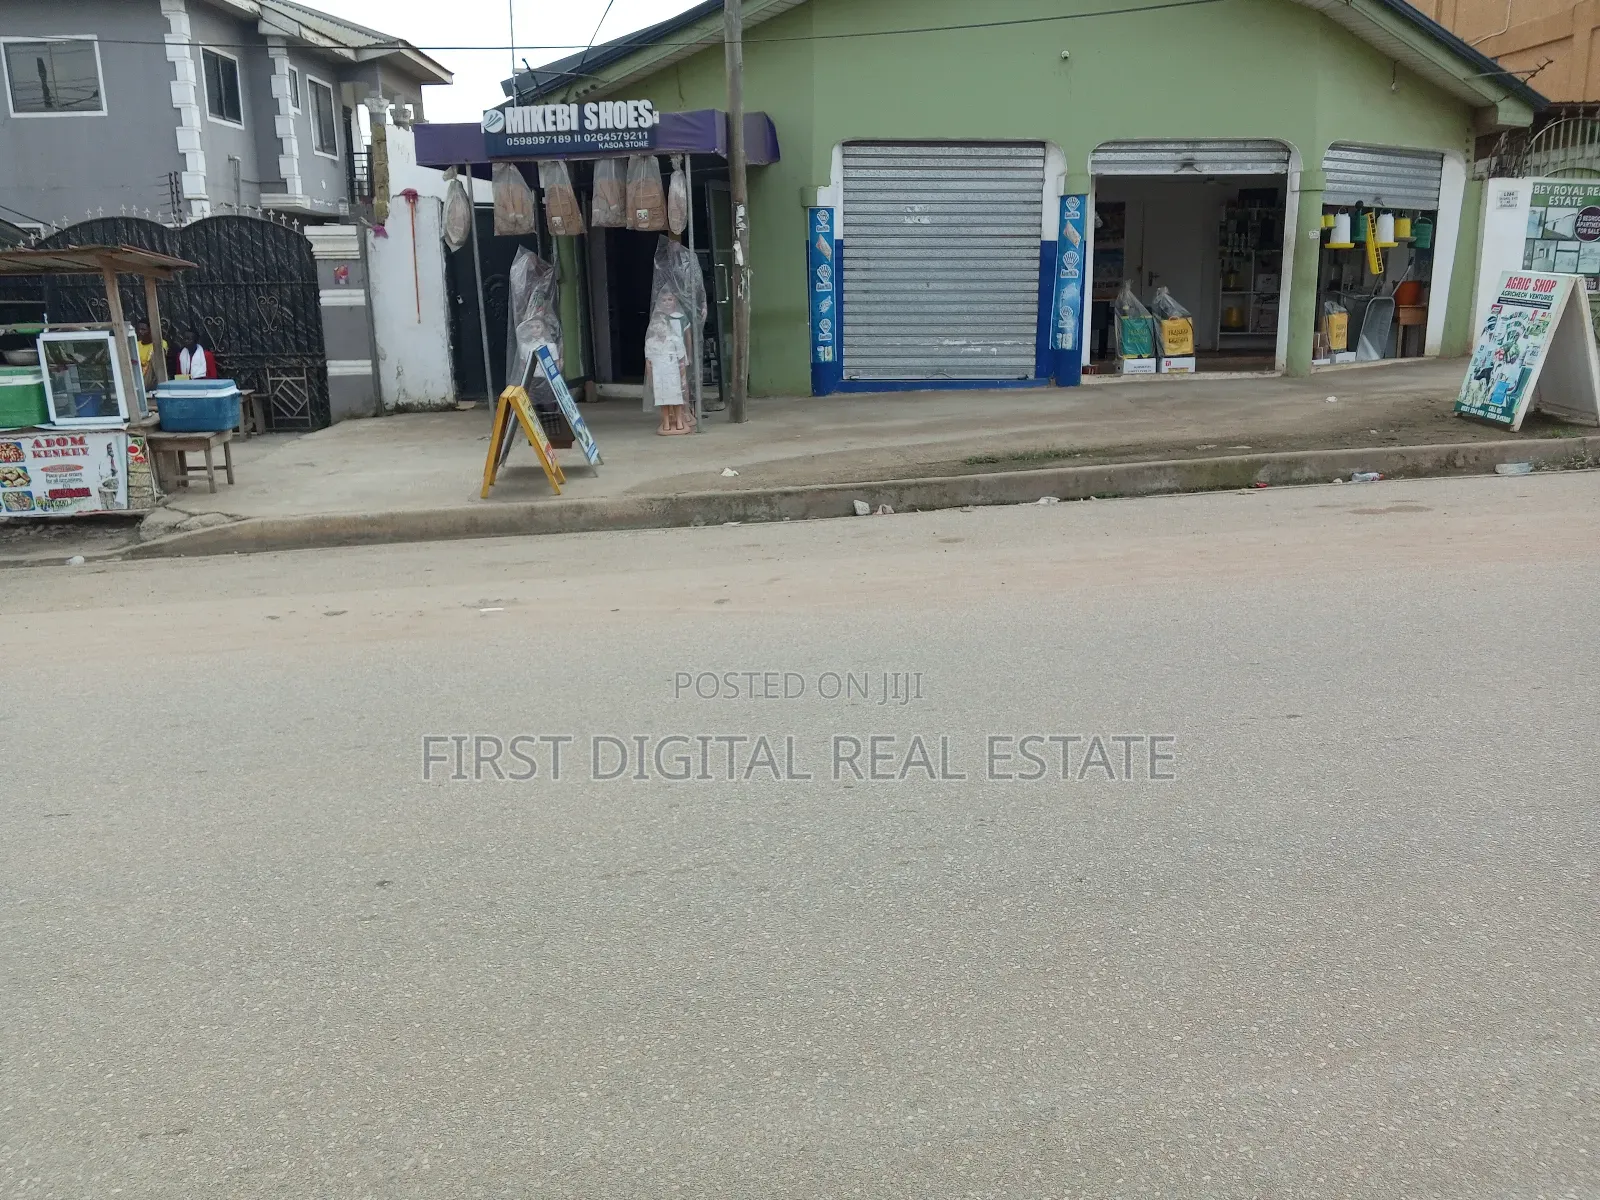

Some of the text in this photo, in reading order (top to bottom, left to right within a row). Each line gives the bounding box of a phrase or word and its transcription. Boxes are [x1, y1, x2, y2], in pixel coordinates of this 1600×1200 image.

[504, 99, 654, 134] MIKEBI SHOES
[506, 134, 571, 146] 0598997189
[584, 131, 649, 142] 0264579211
[1533, 184, 1600, 197] BEY ROYAL RE
[1548, 195, 1584, 206] ESTATE
[1505, 276, 1557, 293] AGRIC SHOP
[1529, 293, 1554, 301] VENTURES
[32, 436, 88, 448] ADOM
[32, 447, 89, 458] KENKEY
